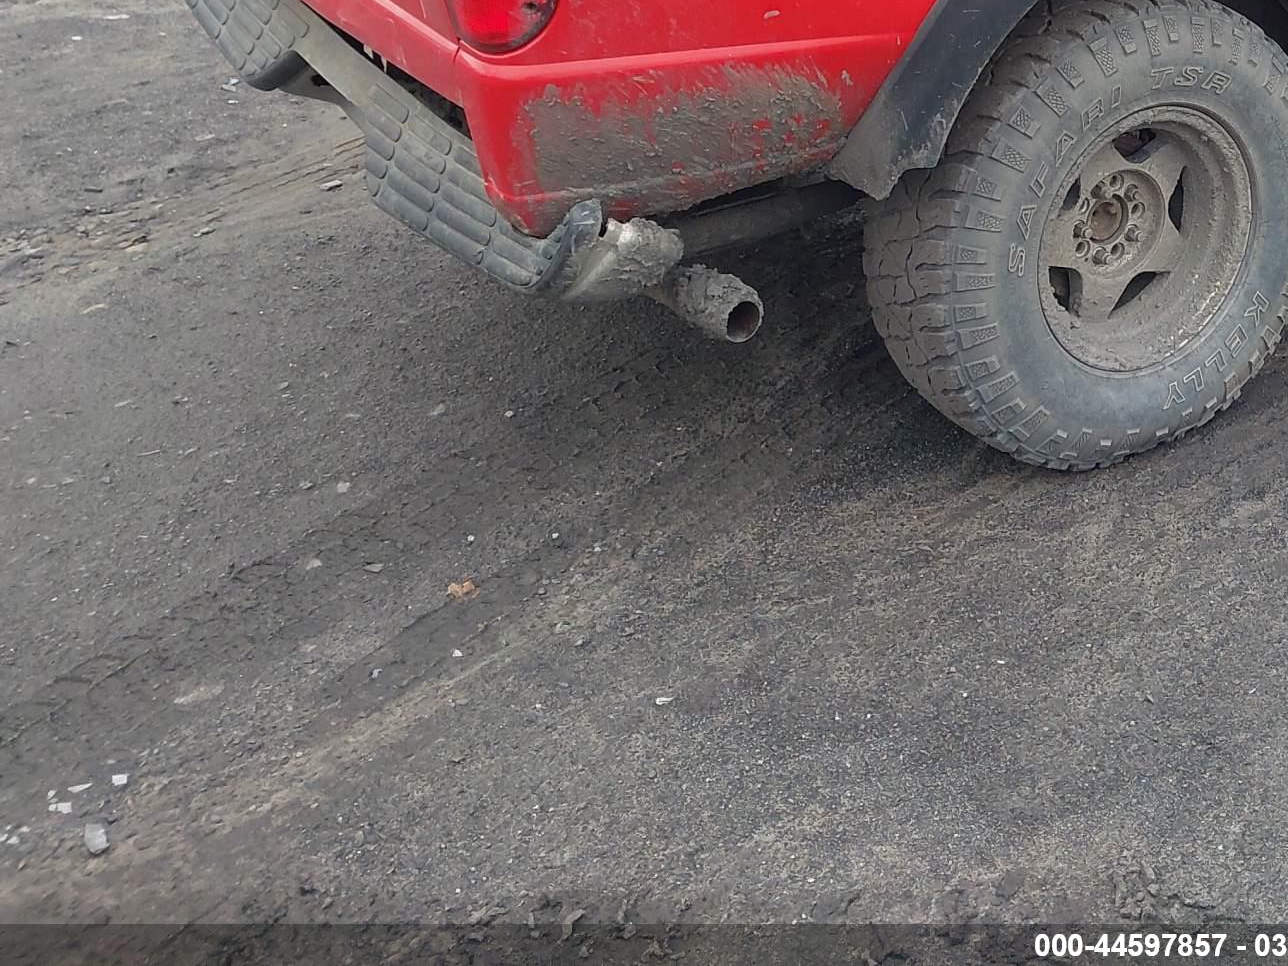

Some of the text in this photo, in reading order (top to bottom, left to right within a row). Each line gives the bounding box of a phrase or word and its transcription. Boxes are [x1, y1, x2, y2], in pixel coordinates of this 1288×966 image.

[1008, 65, 1231, 277] SAFARI TSR
[1163, 291, 1268, 410] KELLY
